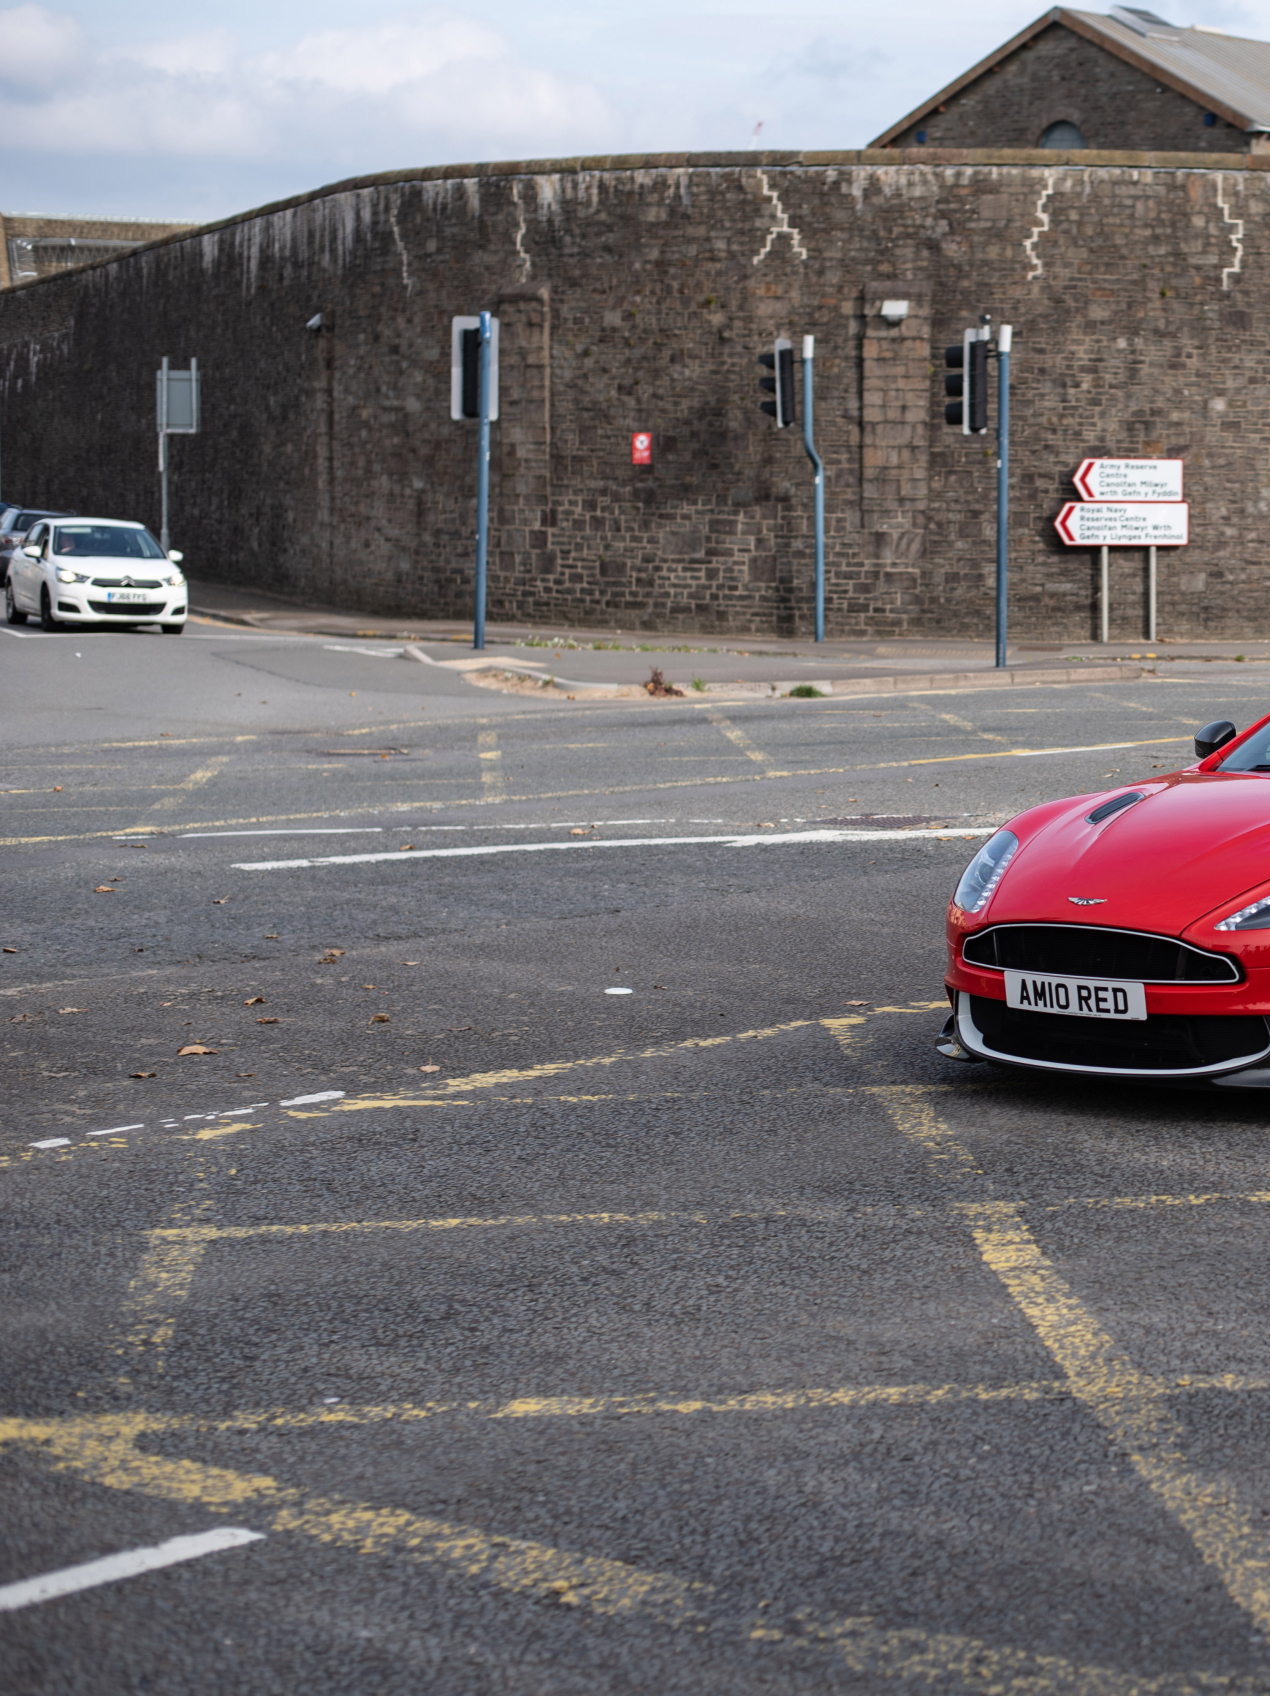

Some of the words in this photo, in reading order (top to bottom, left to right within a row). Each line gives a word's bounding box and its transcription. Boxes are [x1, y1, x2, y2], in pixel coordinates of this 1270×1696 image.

[1099, 462, 1121, 471] Army
[1124, 462, 1158, 470] Reserve
[1099, 471, 1128, 479] Centre
[1099, 480, 1137, 488] Canolfan
[1140, 480, 1168, 489] Milwyr
[1099, 489, 1118, 497] wrth
[1121, 489, 1142, 497] Gefn
[1151, 489, 1179, 498] Fyddin
[1079, 506, 1103, 515] Royal
[1106, 506, 1127, 514] Navy
[1079, 515, 1117, 523] Reserves
[1118, 515, 1147, 523] Centre
[1079, 524, 1117, 532] Canolfan
[1120, 524, 1148, 533] Milwyr
[1151, 524, 1172, 532] Wrth
[1079, 533, 1100, 541] Gefn
[1102, 534, 1107, 542] y
[1110, 533, 1142, 542] Llynges
[1145, 533, 1184, 541] Frenhinol
[1019, 978, 1071, 1010] AM10
[1076, 984, 1129, 1014] RED
